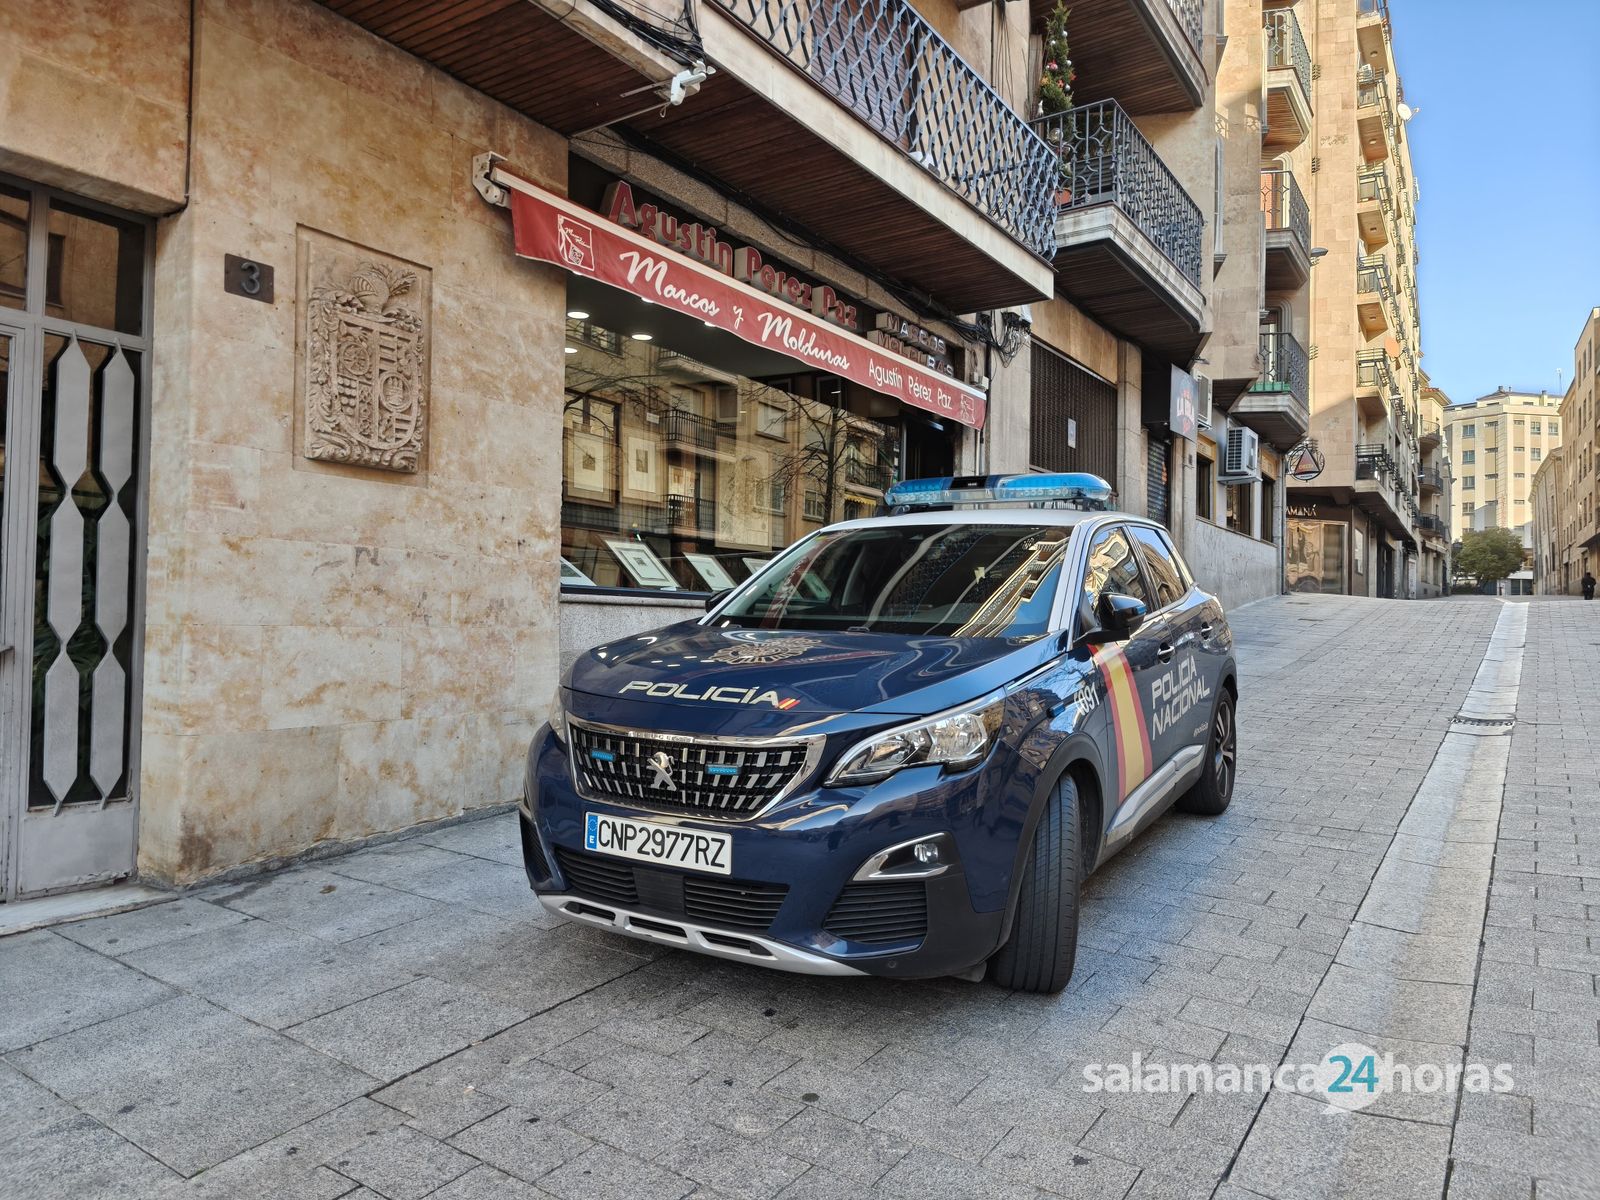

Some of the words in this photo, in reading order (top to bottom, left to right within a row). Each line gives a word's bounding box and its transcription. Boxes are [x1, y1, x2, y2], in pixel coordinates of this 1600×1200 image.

[240, 261, 260, 294] 3
[606, 180, 734, 277] Agustin
[744, 246, 812, 308] Perez
[822, 286, 858, 329] Paz
[619, 251, 720, 317] Marcos
[733, 305, 744, 330] y
[758, 312, 850, 370] Molduras
[886, 312, 946, 355] MARCOS
[869, 358, 902, 390] Agustín
[908, 375, 932, 402] Pérez
[937, 388, 953, 410] Paz
[618, 680, 779, 708] POLICÍA
[1152, 675, 1211, 741] NACIONAL
[589, 835, 595, 844] E
[598, 819, 726, 869] CNP2977RZ
